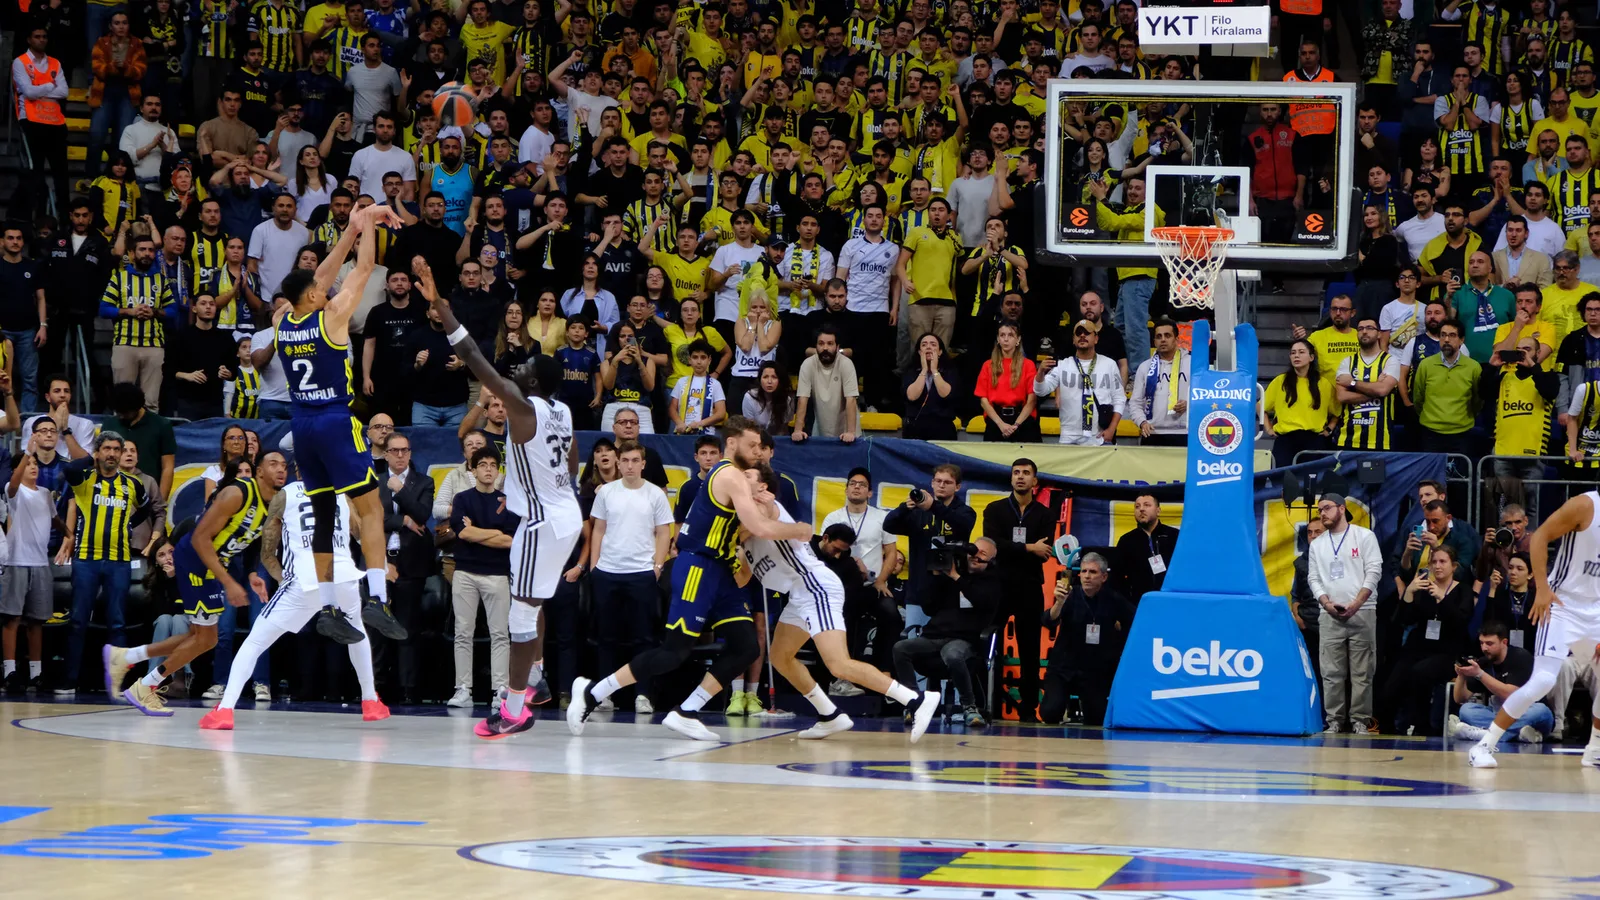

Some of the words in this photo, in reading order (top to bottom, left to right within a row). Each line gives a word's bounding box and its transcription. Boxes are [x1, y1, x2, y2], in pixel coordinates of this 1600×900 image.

[1145, 15, 1199, 36] YKT
[1211, 15, 1232, 25] Filo
[1211, 25, 1263, 36] Kiralama
[1062, 226, 1096, 236] EuroLeague
[1297, 232, 1331, 242] EuroLeague
[603, 262, 632, 273] AVIS
[126, 296, 155, 308] AVIS
[278, 329, 310, 343] BALDWIN
[308, 326, 320, 340] IV
[293, 342, 316, 355] MSC
[291, 358, 319, 391] 2
[613, 387, 641, 400] beko
[1191, 387, 1252, 401] SPALDING
[1502, 400, 1535, 413] beko
[1352, 416, 1375, 425] misli
[1196, 459, 1243, 476] beko
[93, 493, 127, 511] Otokoç
[1351, 547, 1359, 557] M
[1152, 637, 1264, 679] beko
